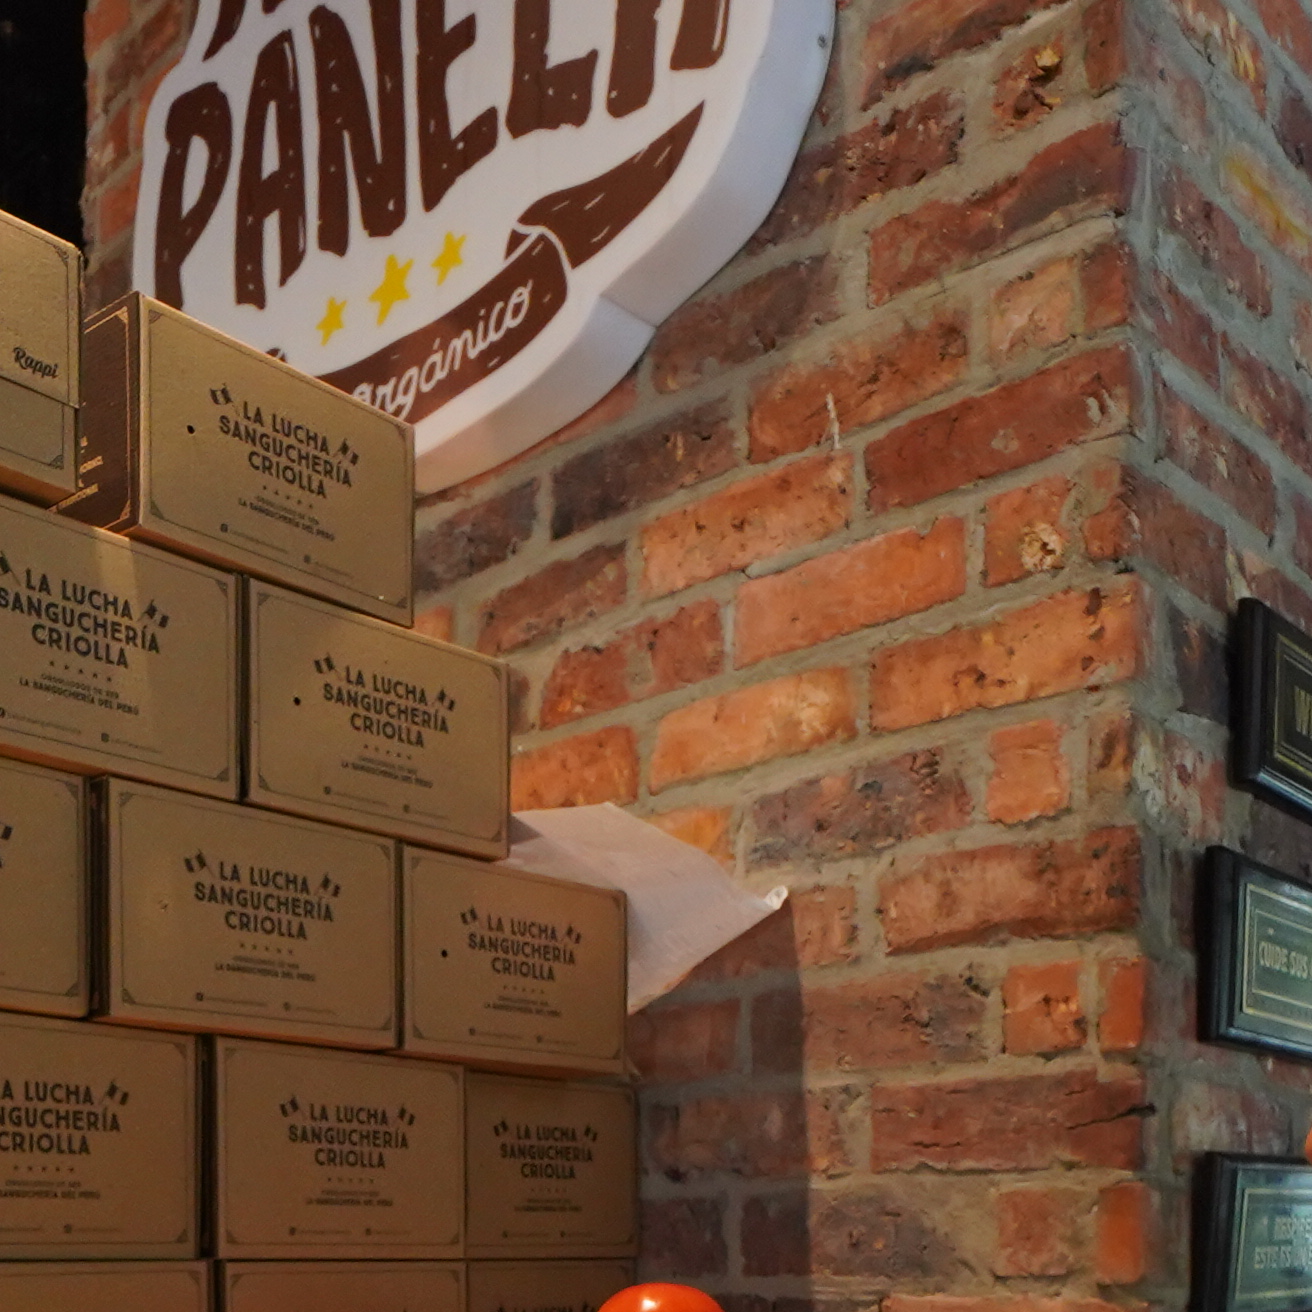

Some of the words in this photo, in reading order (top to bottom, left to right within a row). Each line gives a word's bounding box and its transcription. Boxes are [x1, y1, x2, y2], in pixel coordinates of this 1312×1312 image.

[12, 347, 59, 379] Rappi
[243, 401, 265, 427] LA
[272, 414, 330, 456] LUCHA
[220, 415, 352, 487] SANGUCHERÍA
[248, 451, 327, 498] CRIOLLA
[25, 568, 51, 595] LA
[61, 579, 133, 620] LUCHA
[31, 623, 128, 669] CRIOLLA
[346, 665, 365, 688] LA
[373, 674, 427, 706] LUCHA
[324, 683, 449, 734] SANGUCHERÍA
[350, 713, 424, 748] CRIOLLA
[220, 861, 241, 882] LA
[250, 866, 311, 895] LUCHA
[194, 881, 333, 922] SANGUCHERÍA
[225, 910, 307, 940] CRIOLLA
[488, 914, 504, 932] LA
[511, 919, 558, 942] LUCHA
[468, 931, 575, 964] SANGUCHERÍA
[491, 957, 555, 981] CRIOLLA
[24, 1081, 94, 1106] LUCHA
[309, 1103, 329, 1122] LA
[336, 1105, 388, 1126] LUCHA
[288, 1124, 409, 1150] SANGUCHERÍA
[315, 1148, 386, 1169] CRIOLLA
